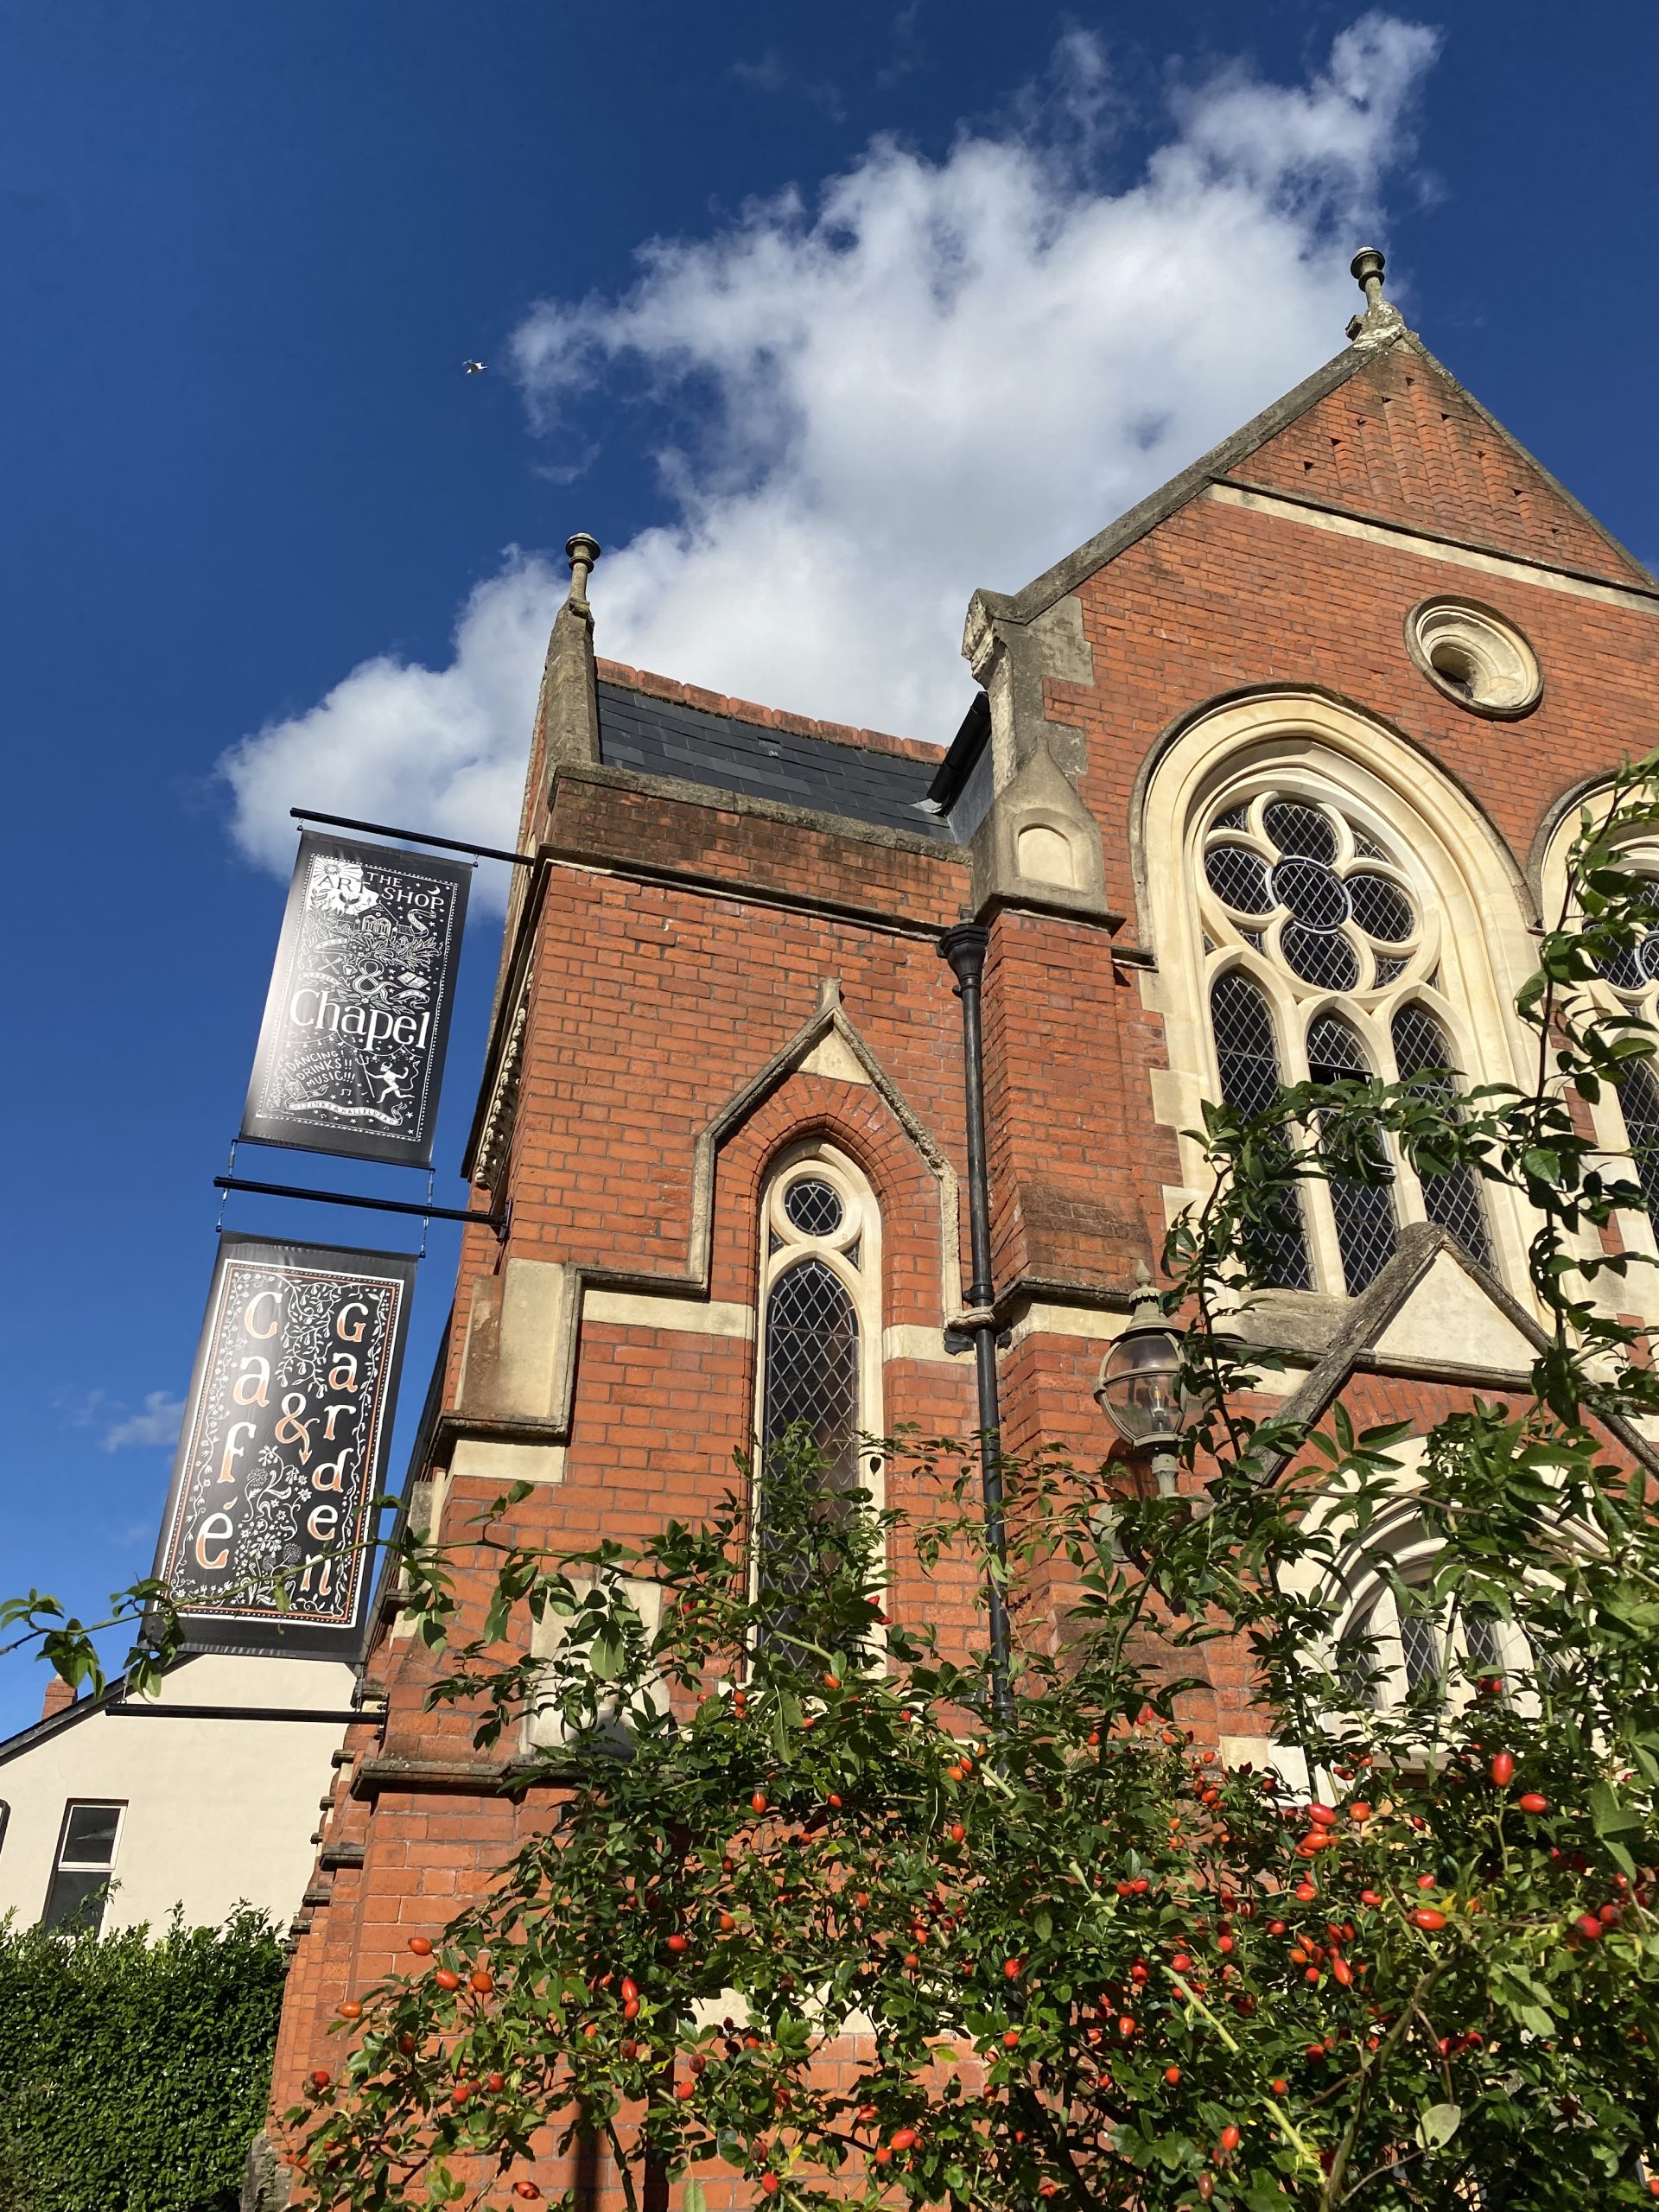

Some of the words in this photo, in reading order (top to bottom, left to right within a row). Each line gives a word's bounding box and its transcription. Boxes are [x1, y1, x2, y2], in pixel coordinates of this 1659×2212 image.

[318, 875, 372, 893] ART
[381, 887, 445, 910] SHOP
[366, 871, 404, 888] THE
[352, 958, 402, 1006] &
[289, 988, 431, 1052] Chapel
[285, 1049, 345, 1072] DANCING!
[296, 1057, 353, 1081] DRINKS!!
[305, 1071, 356, 1089] MUSIC!!!
[195, 1290, 283, 1570] Café
[275, 1392, 321, 1466] &
[299, 1302, 369, 1596] Garden
